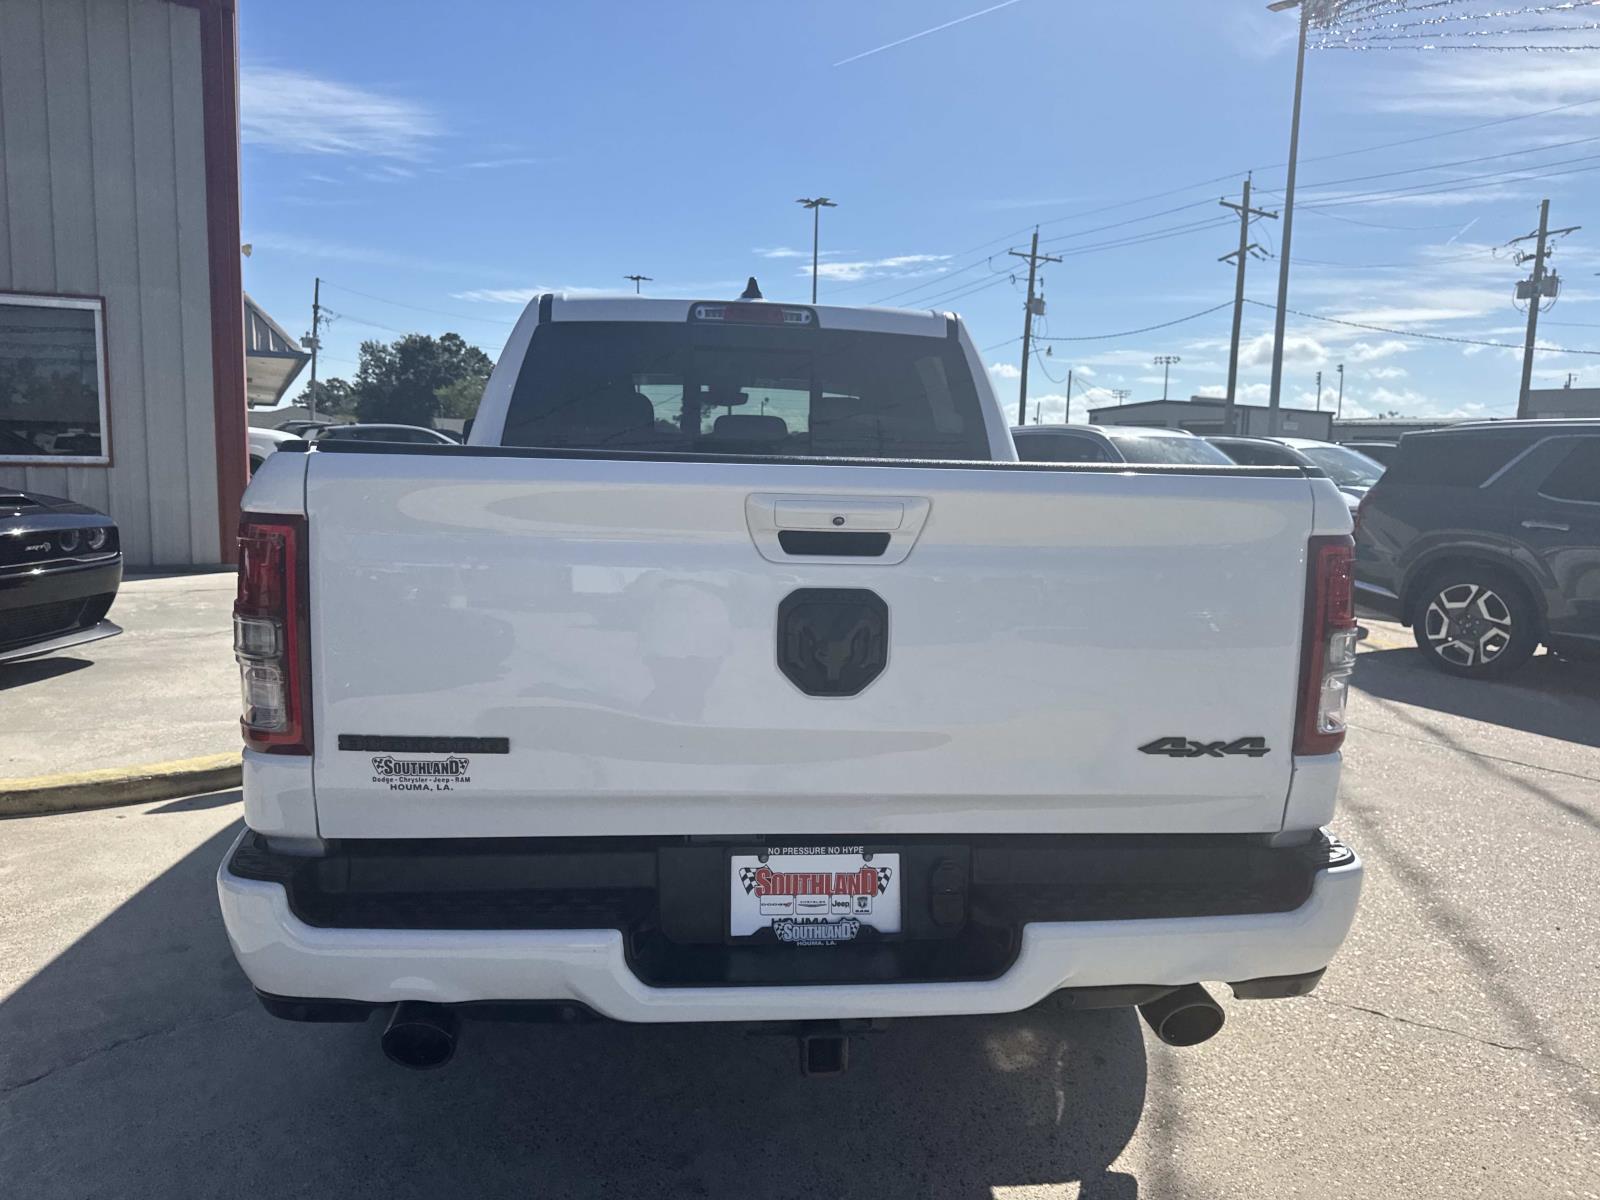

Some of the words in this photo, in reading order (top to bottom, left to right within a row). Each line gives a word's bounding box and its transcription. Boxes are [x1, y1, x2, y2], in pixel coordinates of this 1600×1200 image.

[1137, 736, 1271, 757] 4x4
[383, 759, 460, 775] SOUTHLAND
[768, 847, 780, 855] NO
[782, 847, 826, 855] PRESSURE
[828, 846, 840, 854] NO
[841, 846, 864, 854] HYPE
[754, 867, 878, 897] SOUTHLAND
[831, 900, 850, 908] Jeep
[783, 923, 851, 940] SOUTHLAND
